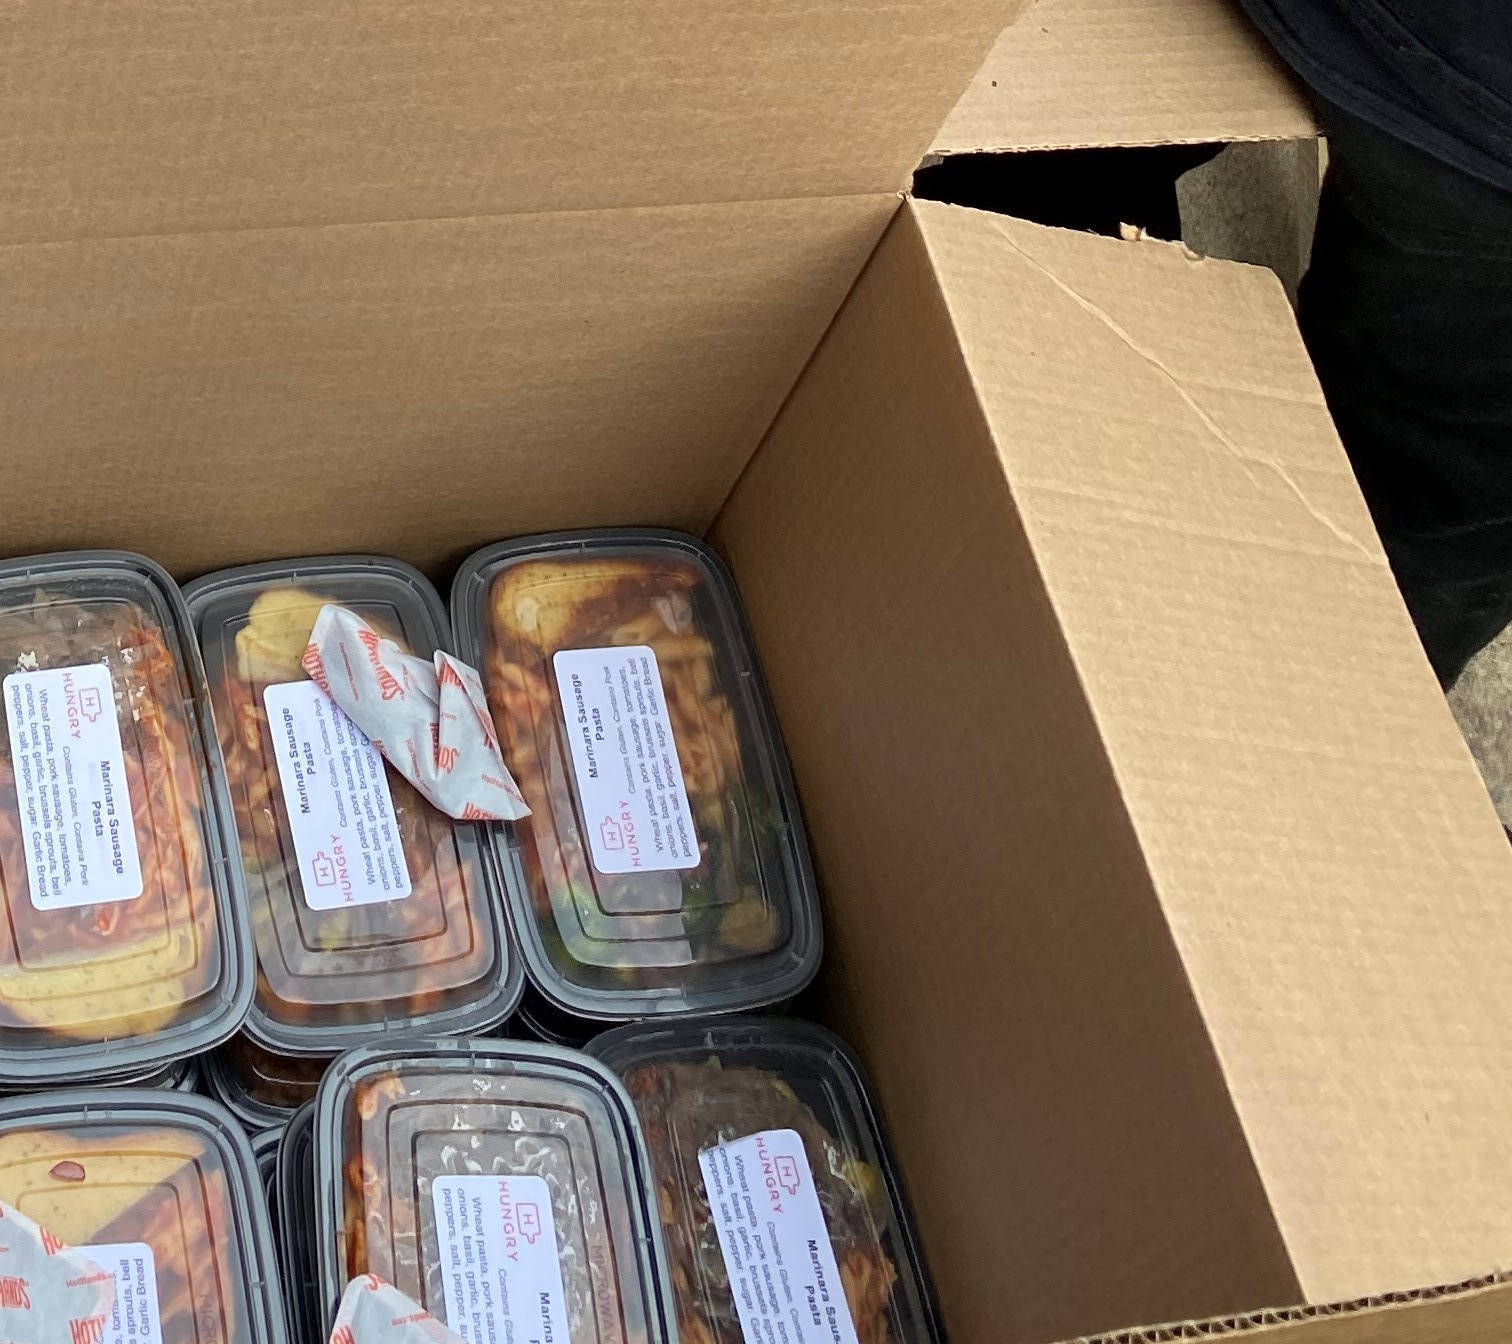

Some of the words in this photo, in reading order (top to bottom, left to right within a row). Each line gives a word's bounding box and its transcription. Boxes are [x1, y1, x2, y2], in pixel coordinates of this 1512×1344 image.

[10, 684, 24, 728] peppers,
[24, 682, 36, 719] onions,
[38, 688, 51, 722] Wheat
[62, 672, 81, 739] HUNGRY
[84, 696, 96, 707] H
[571, 674, 588, 724] Sausage
[18, 730, 29, 752] salt,
[30, 722, 42, 748] basil,
[41, 724, 54, 755] pasta,
[282, 707, 299, 759] Sausage
[591, 708, 605, 741] Pasta
[31, 750, 45, 782] garlic,
[46, 757, 59, 780] pork
[302, 741, 317, 775] Pasta
[340, 746, 356, 791] sausage,
[582, 726, 599, 778] Marinara
[19, 754, 34, 793] pepper,
[293, 760, 311, 814] Marinara
[38, 784, 52, 828] brussels
[51, 783, 64, 830] sausage,
[91, 800, 104, 837] Pasta
[100, 760, 116, 816] Marinara
[108, 818, 124, 874] Sausage
[350, 792, 363, 816] pork
[32, 830, 44, 863] Garlic
[43, 831, 58, 874] sprouts,
[356, 818, 370, 849] pasta,
[606, 831, 617, 841] H
[618, 800, 642, 867] HUNGRY
[58, 833, 72, 886] tomatoes,
[318, 866, 330, 877] H
[330, 834, 354, 902] HUNGRY
[361, 850, 376, 885] Wheat
[36, 864, 50, 898] Bread
[51, 876, 62, 896] bell
[754, 1137, 784, 1214] HUNGRY
[781, 1165, 793, 1177] H
[440, 1188, 457, 1241] peppers,
[456, 1187, 470, 1232] onions,
[471, 1196, 485, 1237] Wheat
[498, 1181, 519, 1263] HUNGRY
[522, 1213, 535, 1225] H
[119, 1259, 131, 1281] bell
[449, 1244, 462, 1270] salt,
[462, 1235, 476, 1267] basil,
[474, 1239, 489, 1278] pasta,
[806, 1239, 830, 1302] Marinara
[133, 1258, 147, 1296] Bread
[451, 1272, 466, 1320] pepper,
[464, 1270, 480, 1309] garlic,
[480, 1280, 494, 1309] pork
[497, 1268, 510, 1316] Contains
[591, 1245, 617, 1344] MICROWAV
[122, 1284, 138, 1335] sprouts,
[137, 1298, 151, 1336] Garlic
[538, 1292, 554, 1344] Marina
[804, 1285, 822, 1326] Pasta
